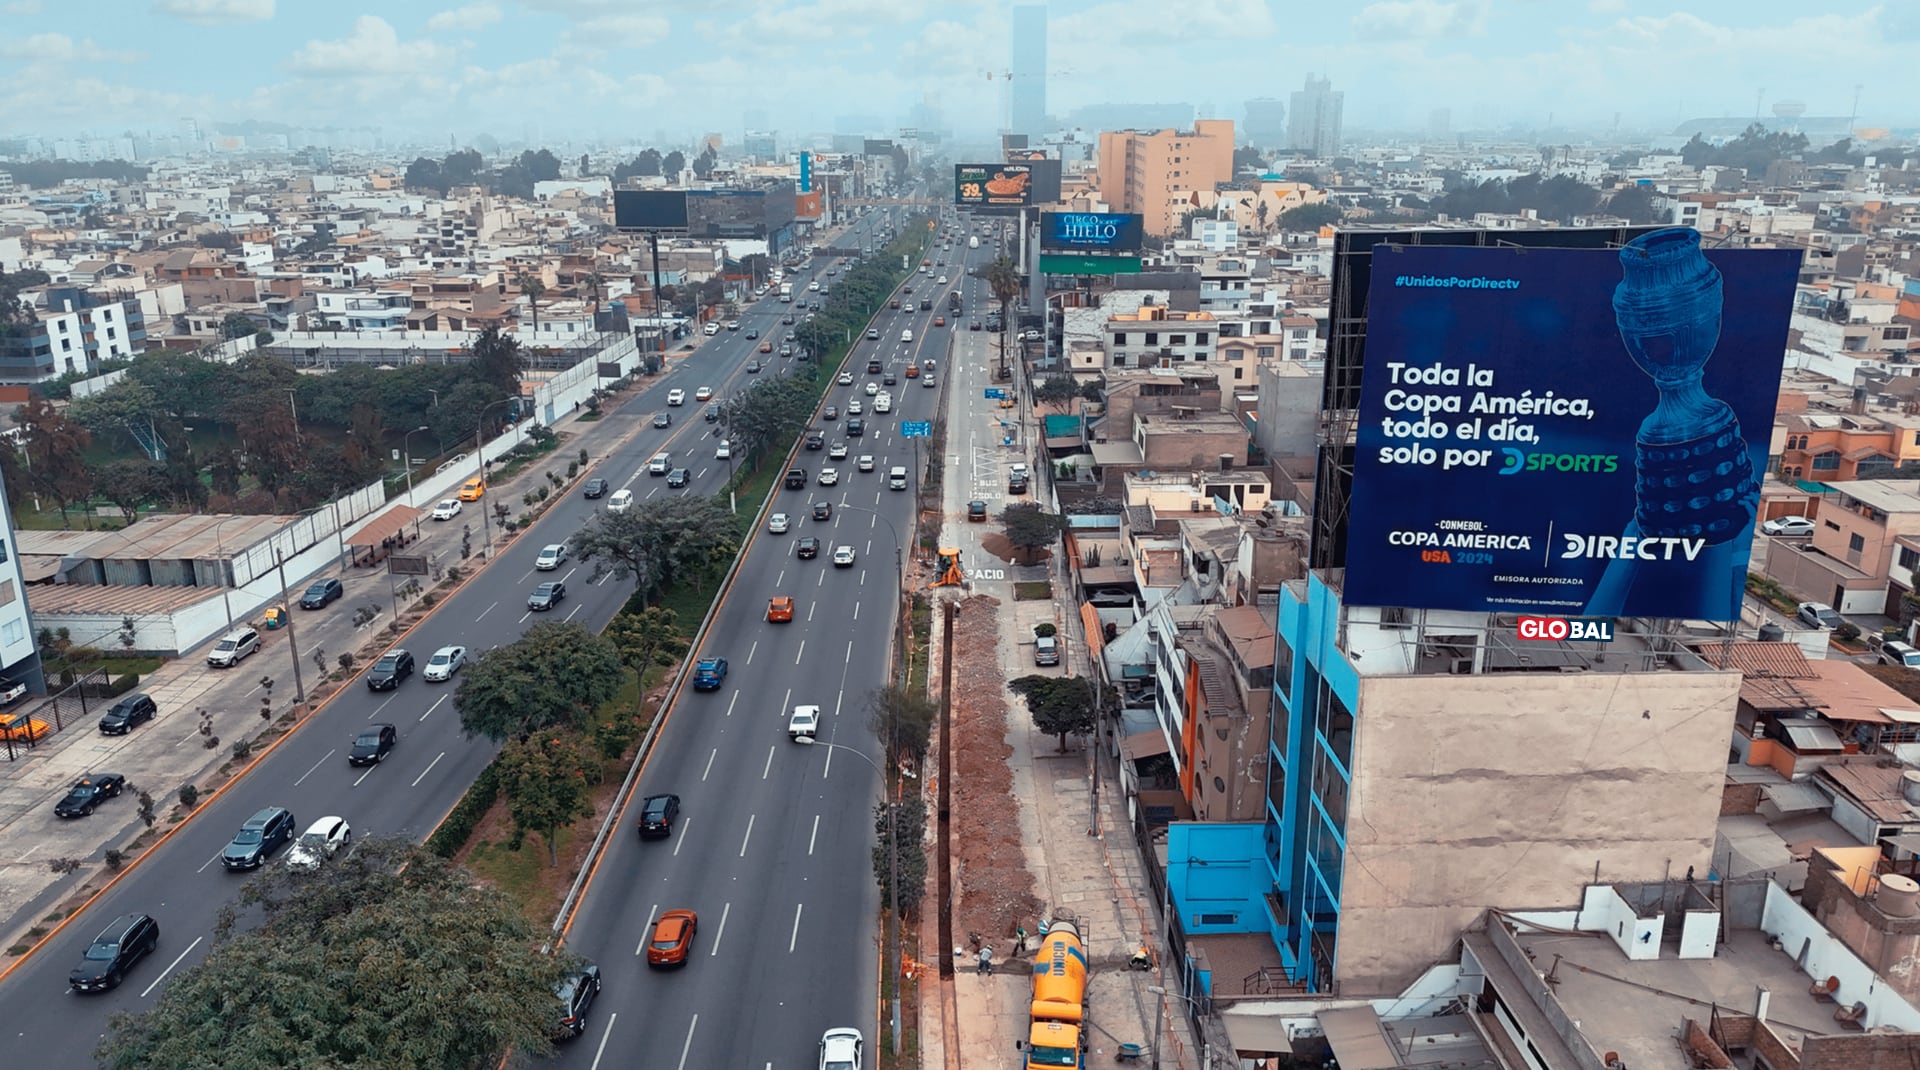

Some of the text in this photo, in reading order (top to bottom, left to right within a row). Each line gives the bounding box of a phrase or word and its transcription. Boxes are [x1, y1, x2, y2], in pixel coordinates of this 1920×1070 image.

[1064, 215, 1099, 224] CIRCO
[1065, 224, 1117, 238] HIELO
[1395, 275, 1520, 289] #UnidosPorDirectv
[1386, 362, 1494, 387] Toda la
[1384, 389, 1595, 420] Copa América,
[1382, 416, 1540, 445] todo el día,
[1378, 442, 1437, 464] solo
[1443, 449, 1492, 470] por
[1388, 531, 1531, 550] COPA AMERICA
[1561, 533, 1706, 561] DIRECTV
[1421, 550, 1494, 564] USA 2024
[967, 569, 1005, 580] PACIO
[1494, 575, 1584, 585] EMISORA AUTORIZADA
[1520, 619, 1611, 640] GLOBAL
